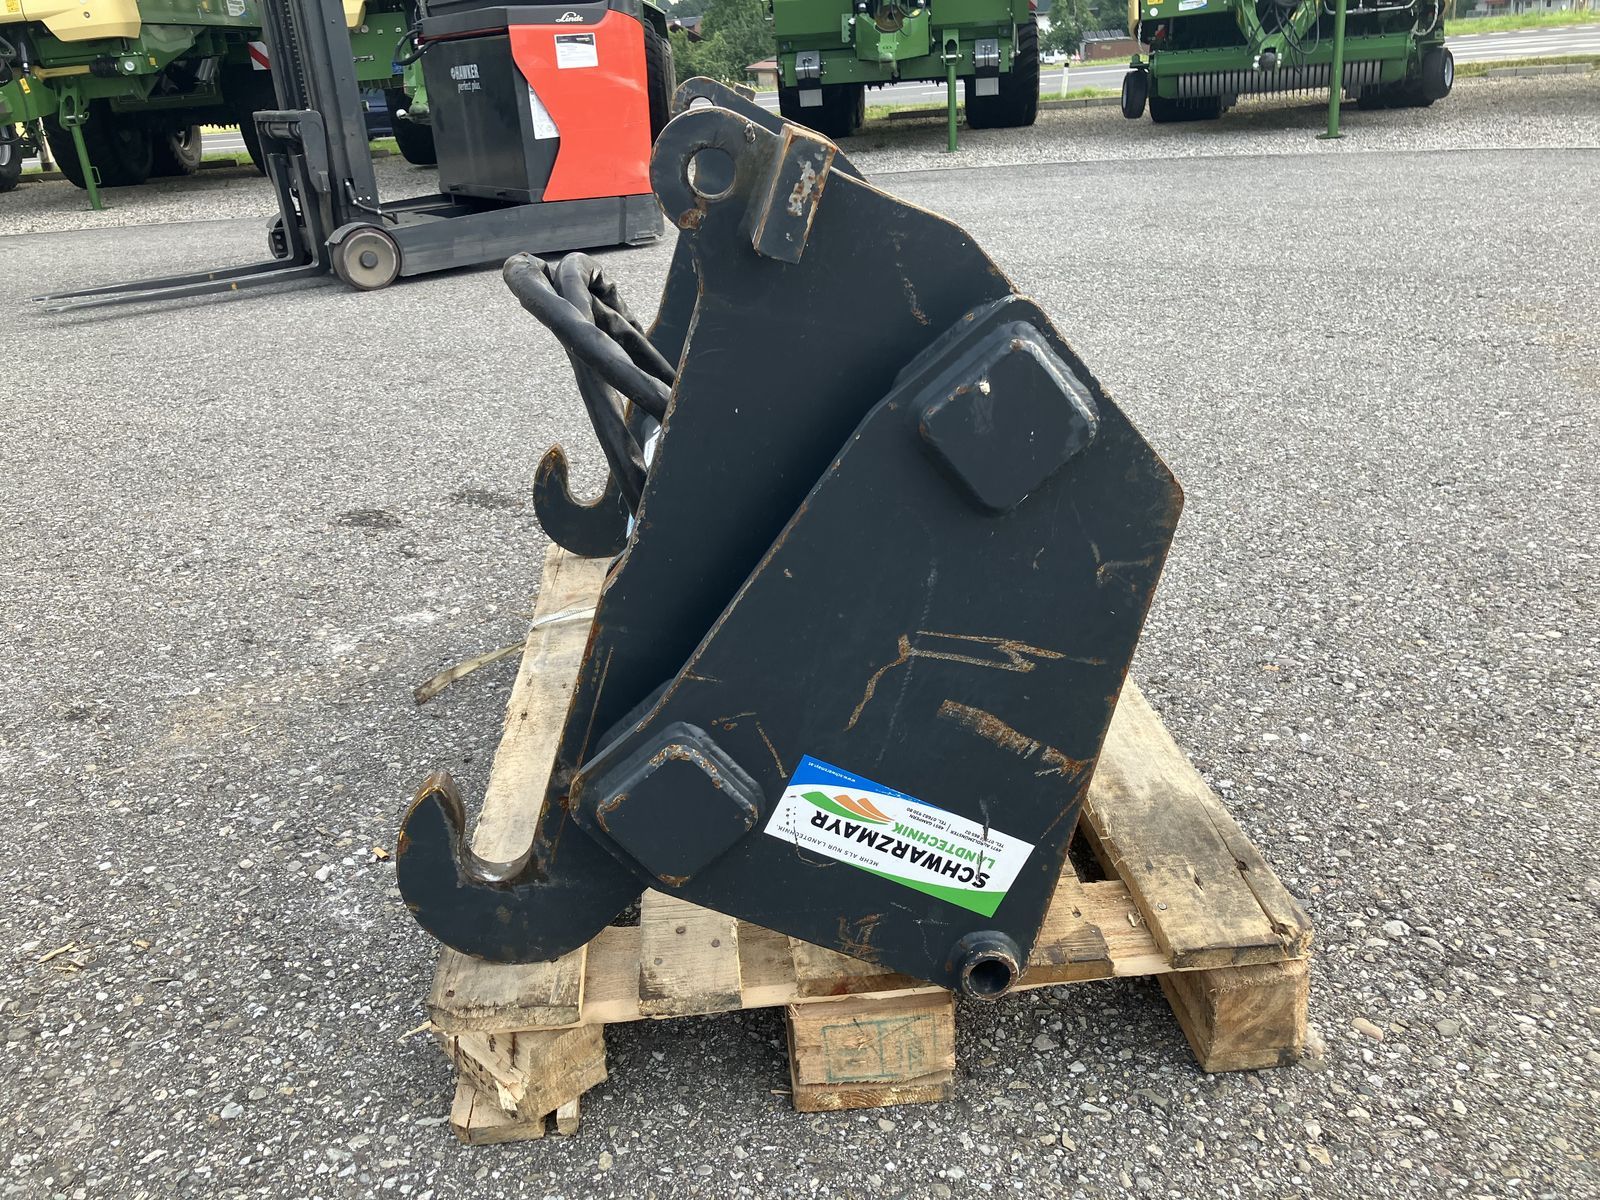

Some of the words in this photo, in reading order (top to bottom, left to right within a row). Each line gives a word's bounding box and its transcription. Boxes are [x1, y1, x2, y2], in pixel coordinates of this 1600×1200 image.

[555, 11, 584, 23] Linde
[809, 762, 855, 782] www.schwarzmayr.at
[909, 815, 932, 825] GAMPERN
[777, 825, 826, 847] LANDTECHNIK.
[811, 811, 990, 888] SCHWARZMAYR
[828, 844, 842, 853] NUR
[892, 822, 995, 869] LANDTECHNIK
[844, 850, 858, 858] ALS
[859, 856, 878, 866] MEHR
